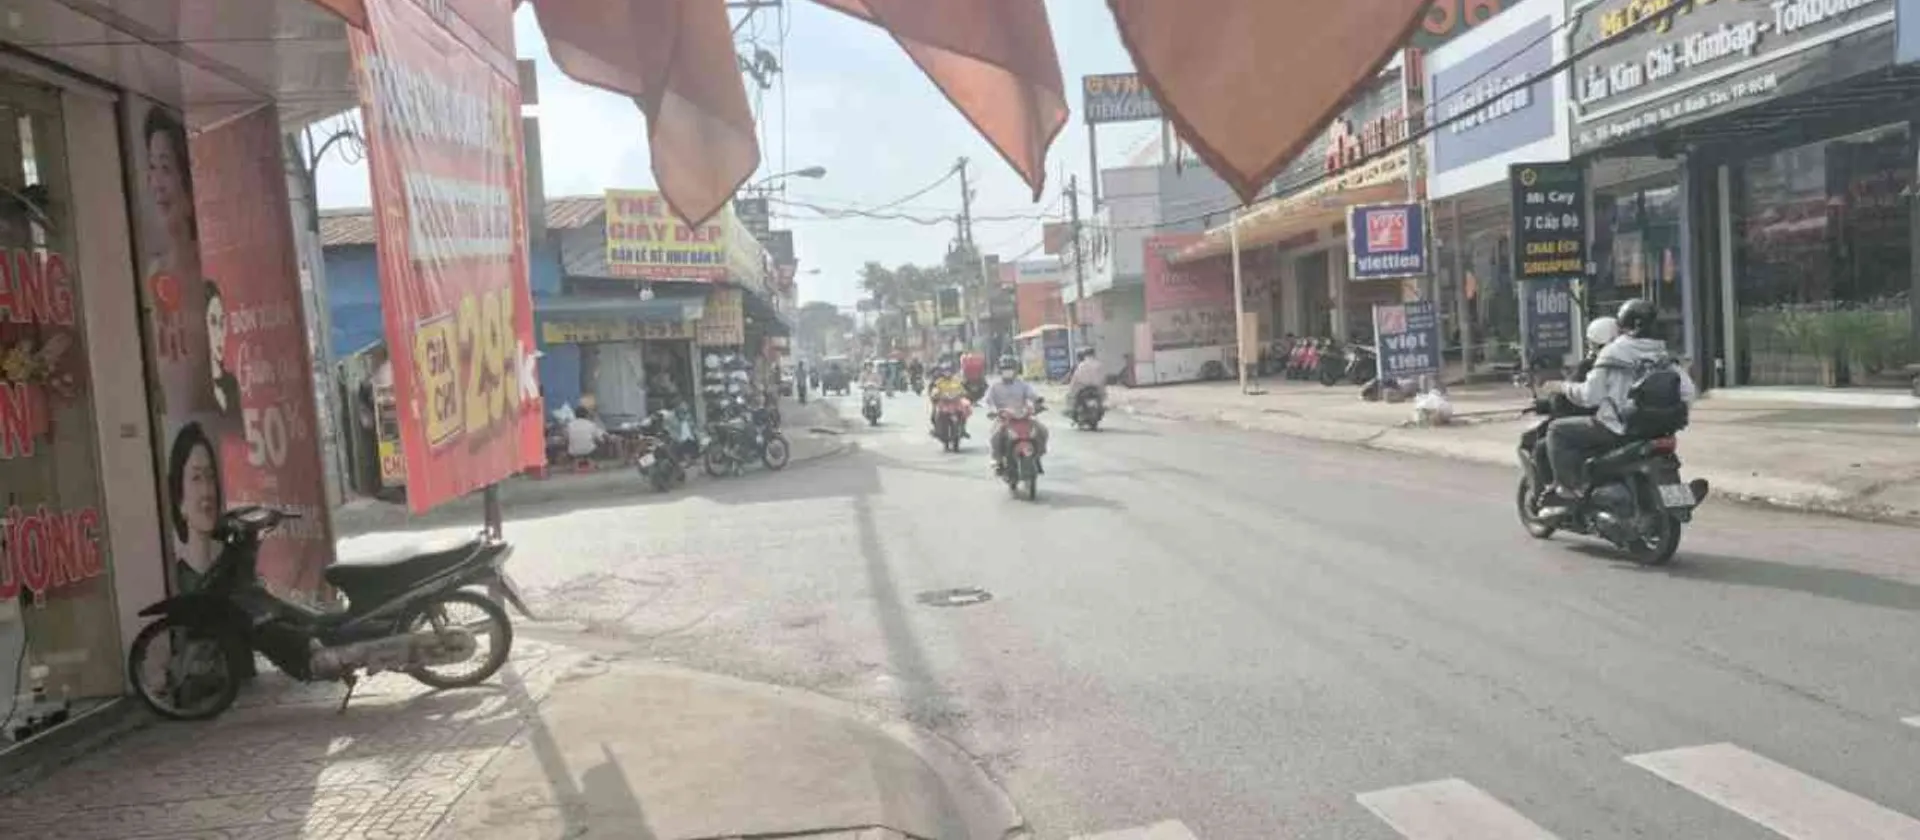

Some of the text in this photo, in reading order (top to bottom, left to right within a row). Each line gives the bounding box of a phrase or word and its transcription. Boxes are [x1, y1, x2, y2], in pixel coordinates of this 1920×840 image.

[1610, 63, 1643, 95] Kim
[1646, 44, 1674, 80] Chi
[1548, 191, 1575, 206] Cay
